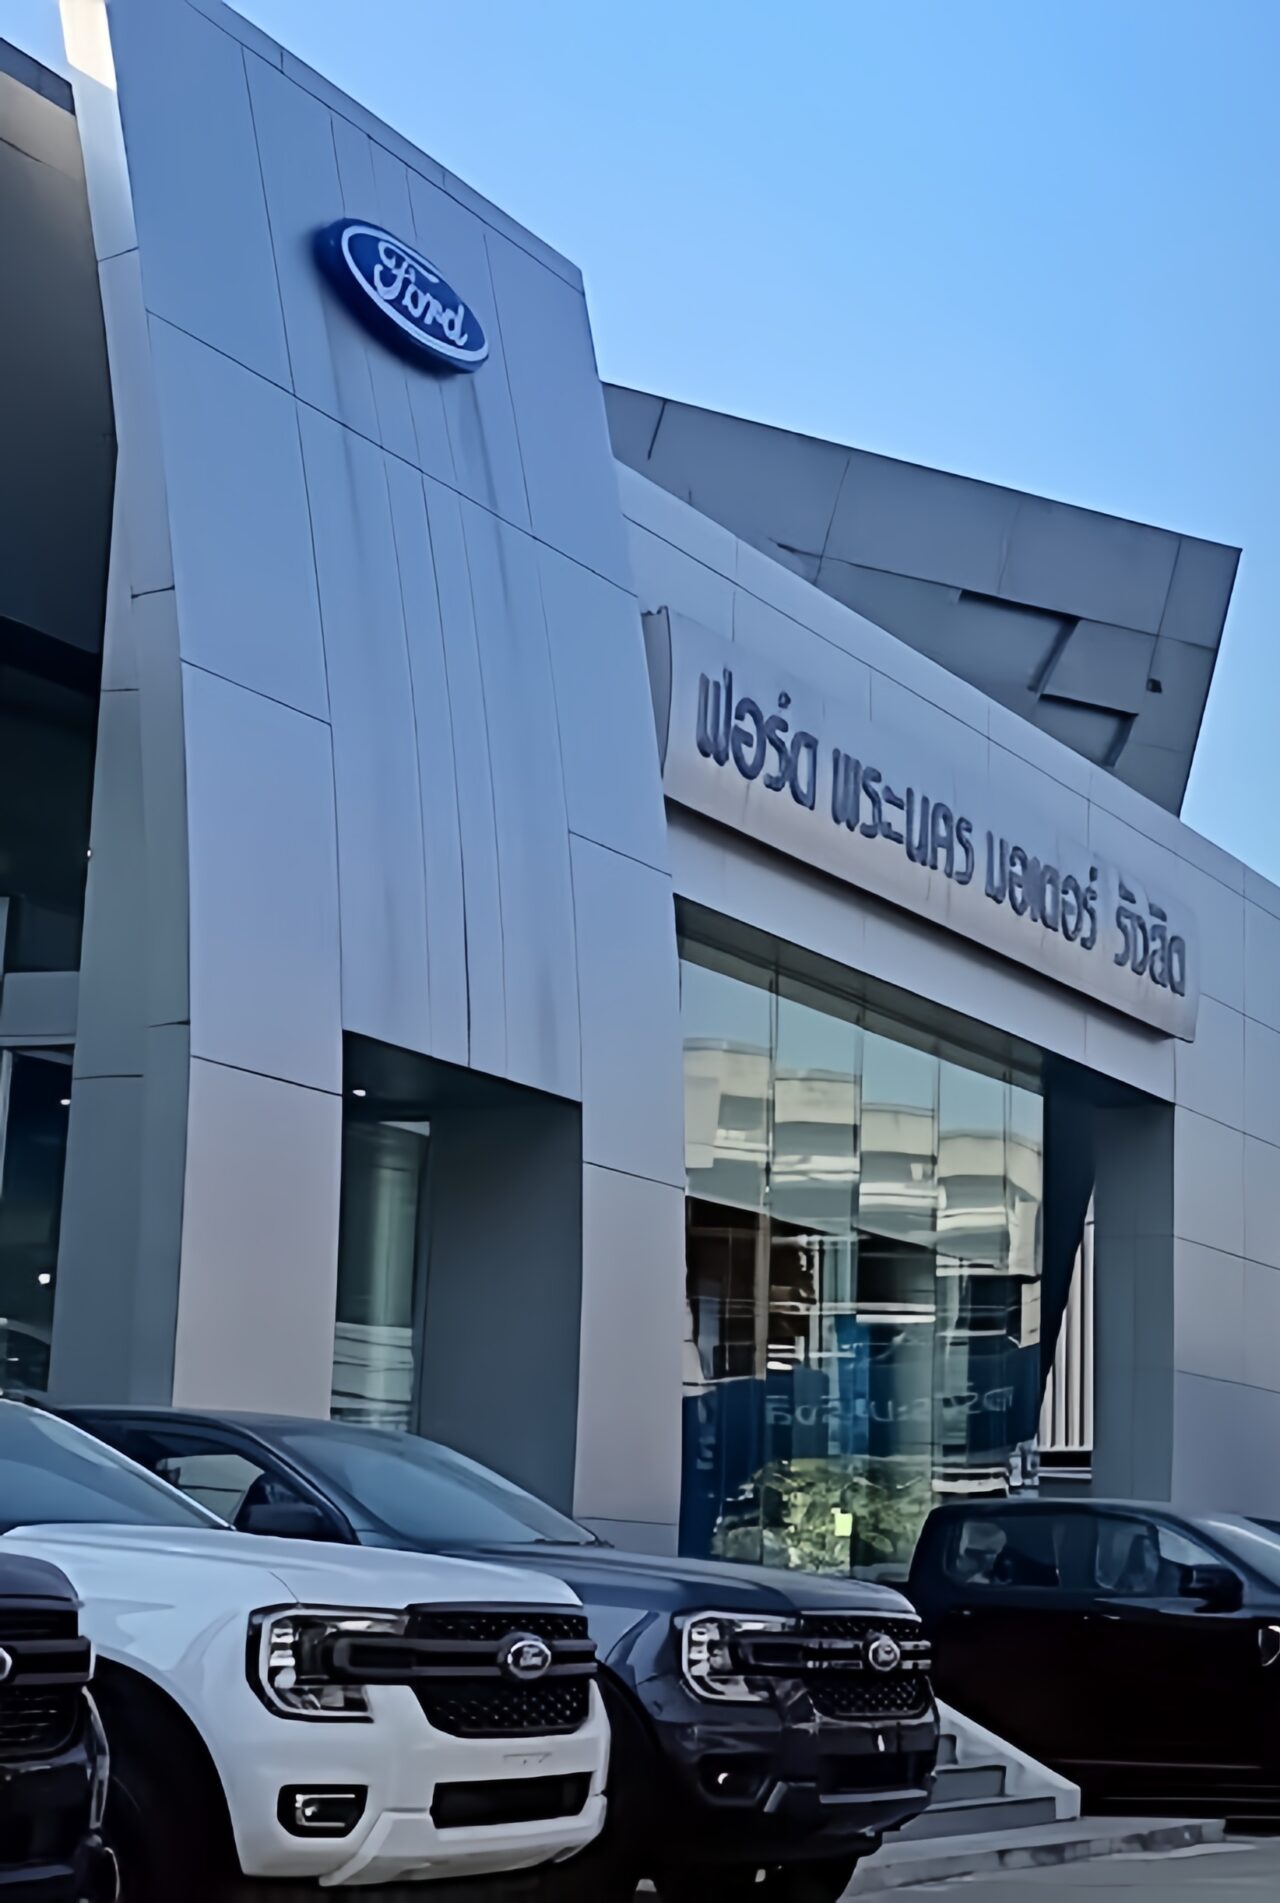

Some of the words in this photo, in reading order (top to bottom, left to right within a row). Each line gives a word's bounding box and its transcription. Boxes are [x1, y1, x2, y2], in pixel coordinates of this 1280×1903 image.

[374, 240, 468, 346] Ford
[696, 666, 818, 810] ฟอร์ด
[832, 748, 975, 885] พระนคร
